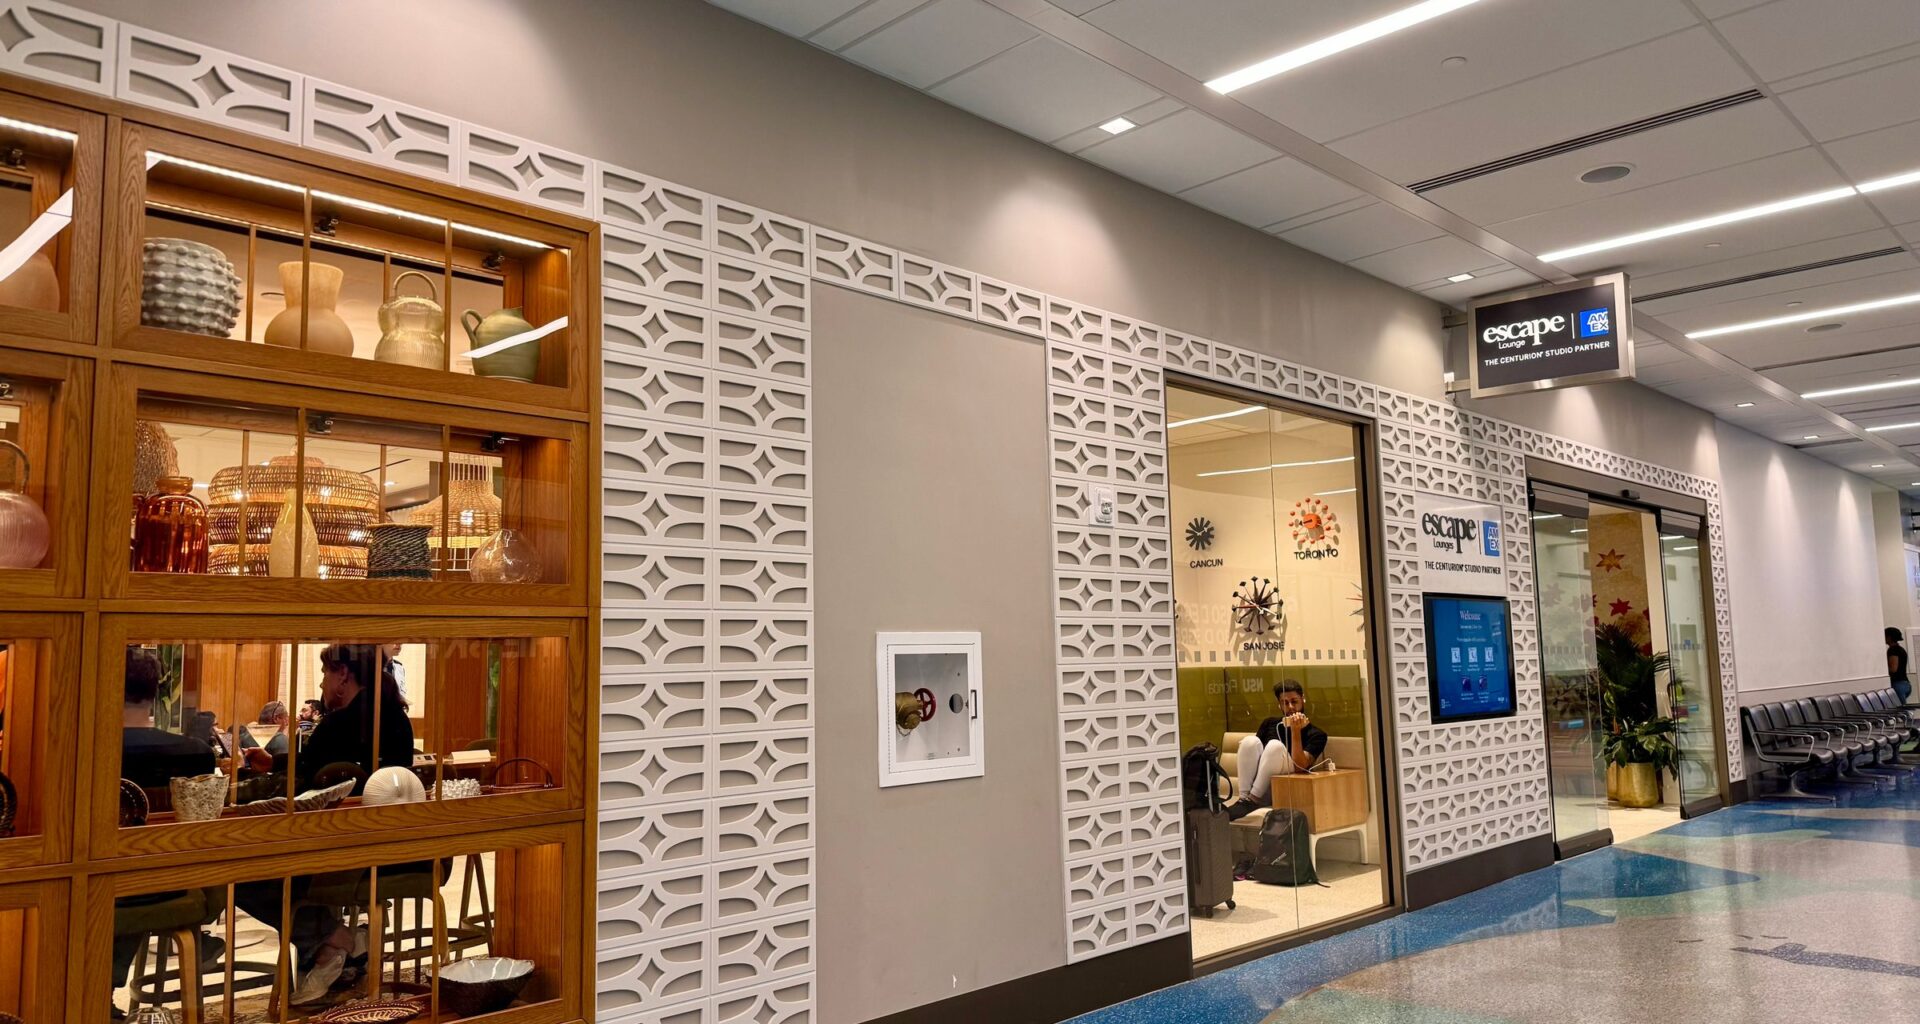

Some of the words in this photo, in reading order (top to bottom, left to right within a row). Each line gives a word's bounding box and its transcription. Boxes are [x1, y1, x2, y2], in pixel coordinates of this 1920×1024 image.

[1483, 315, 1565, 346] escape
[1499, 340, 1526, 349] Lounge
[1485, 358, 1499, 366] THE
[1545, 346, 1573, 357] STUDIO
[1575, 341, 1610, 352] PARTNER
[1422, 512, 1477, 553] escape
[1433, 537, 1454, 552] Lounges
[1294, 549, 1338, 560] TORONTO
[1190, 558, 1223, 569] CANCUN
[1425, 560, 1435, 570] THE
[1465, 564, 1482, 573] STUDIO
[1482, 566, 1501, 575] PARTNER
[1243, 642, 1261, 651] SAN
[1263, 641, 1285, 651] JOSE
